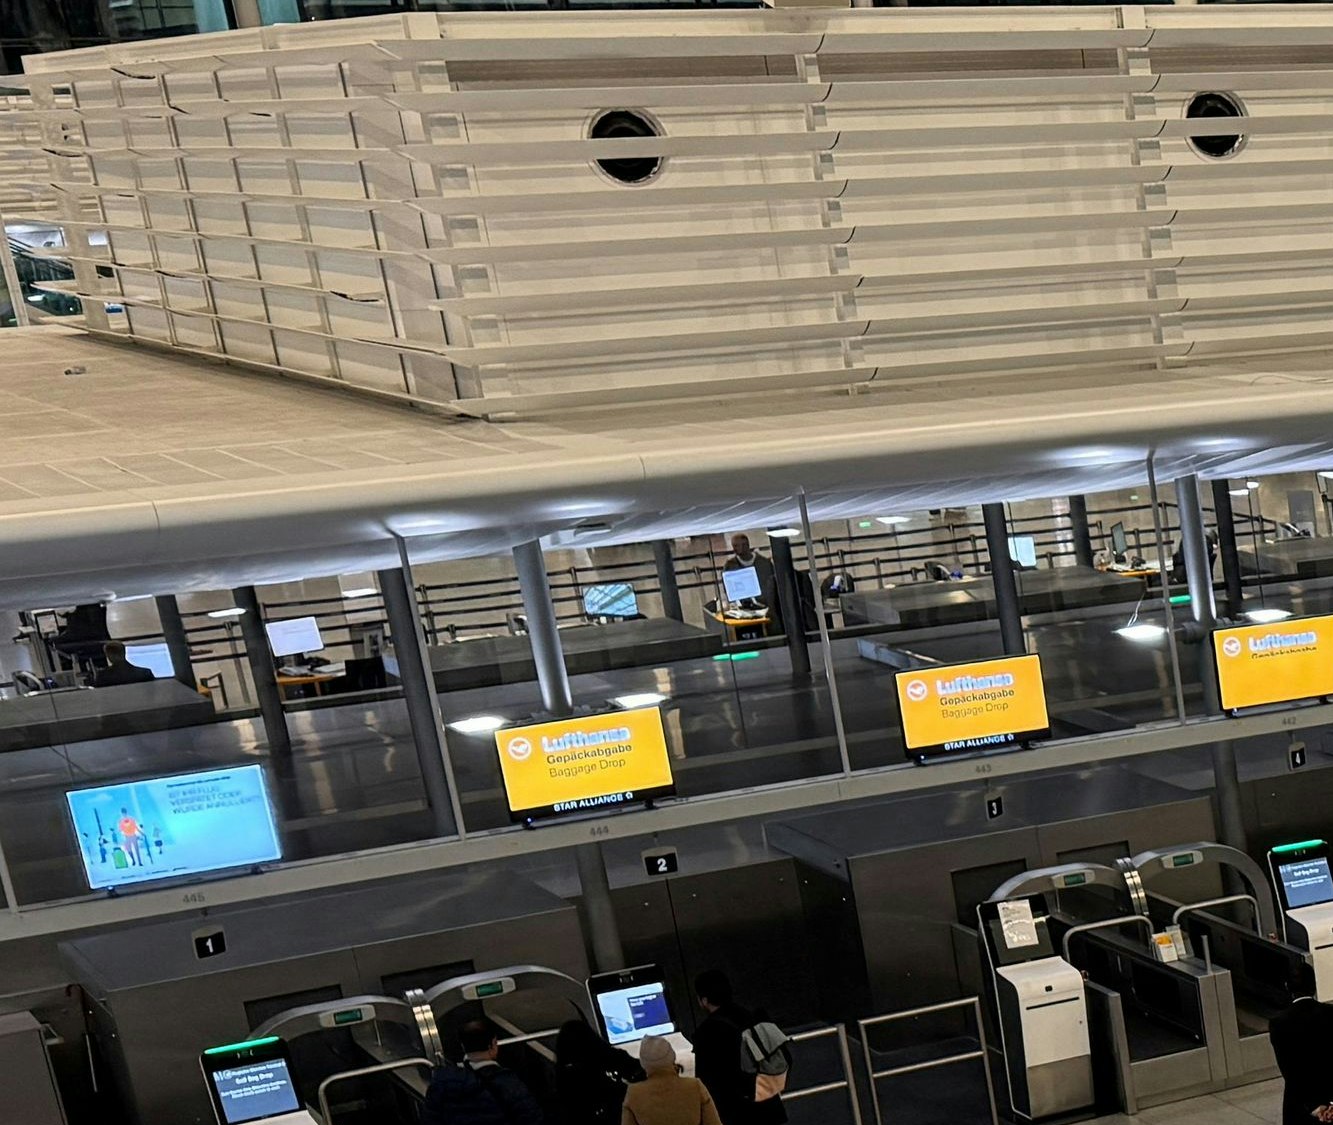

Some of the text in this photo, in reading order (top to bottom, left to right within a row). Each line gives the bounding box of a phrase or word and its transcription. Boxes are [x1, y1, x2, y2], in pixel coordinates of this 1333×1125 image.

[542, 728, 631, 752] Lufthansa
[546, 743, 633, 765] Gepäckabgabe
[549, 757, 627, 779] Baggage Drop
[578, 794, 624, 809] ALLIANCE
[656, 858, 668, 872] 2
[206, 938, 213, 953] 1
